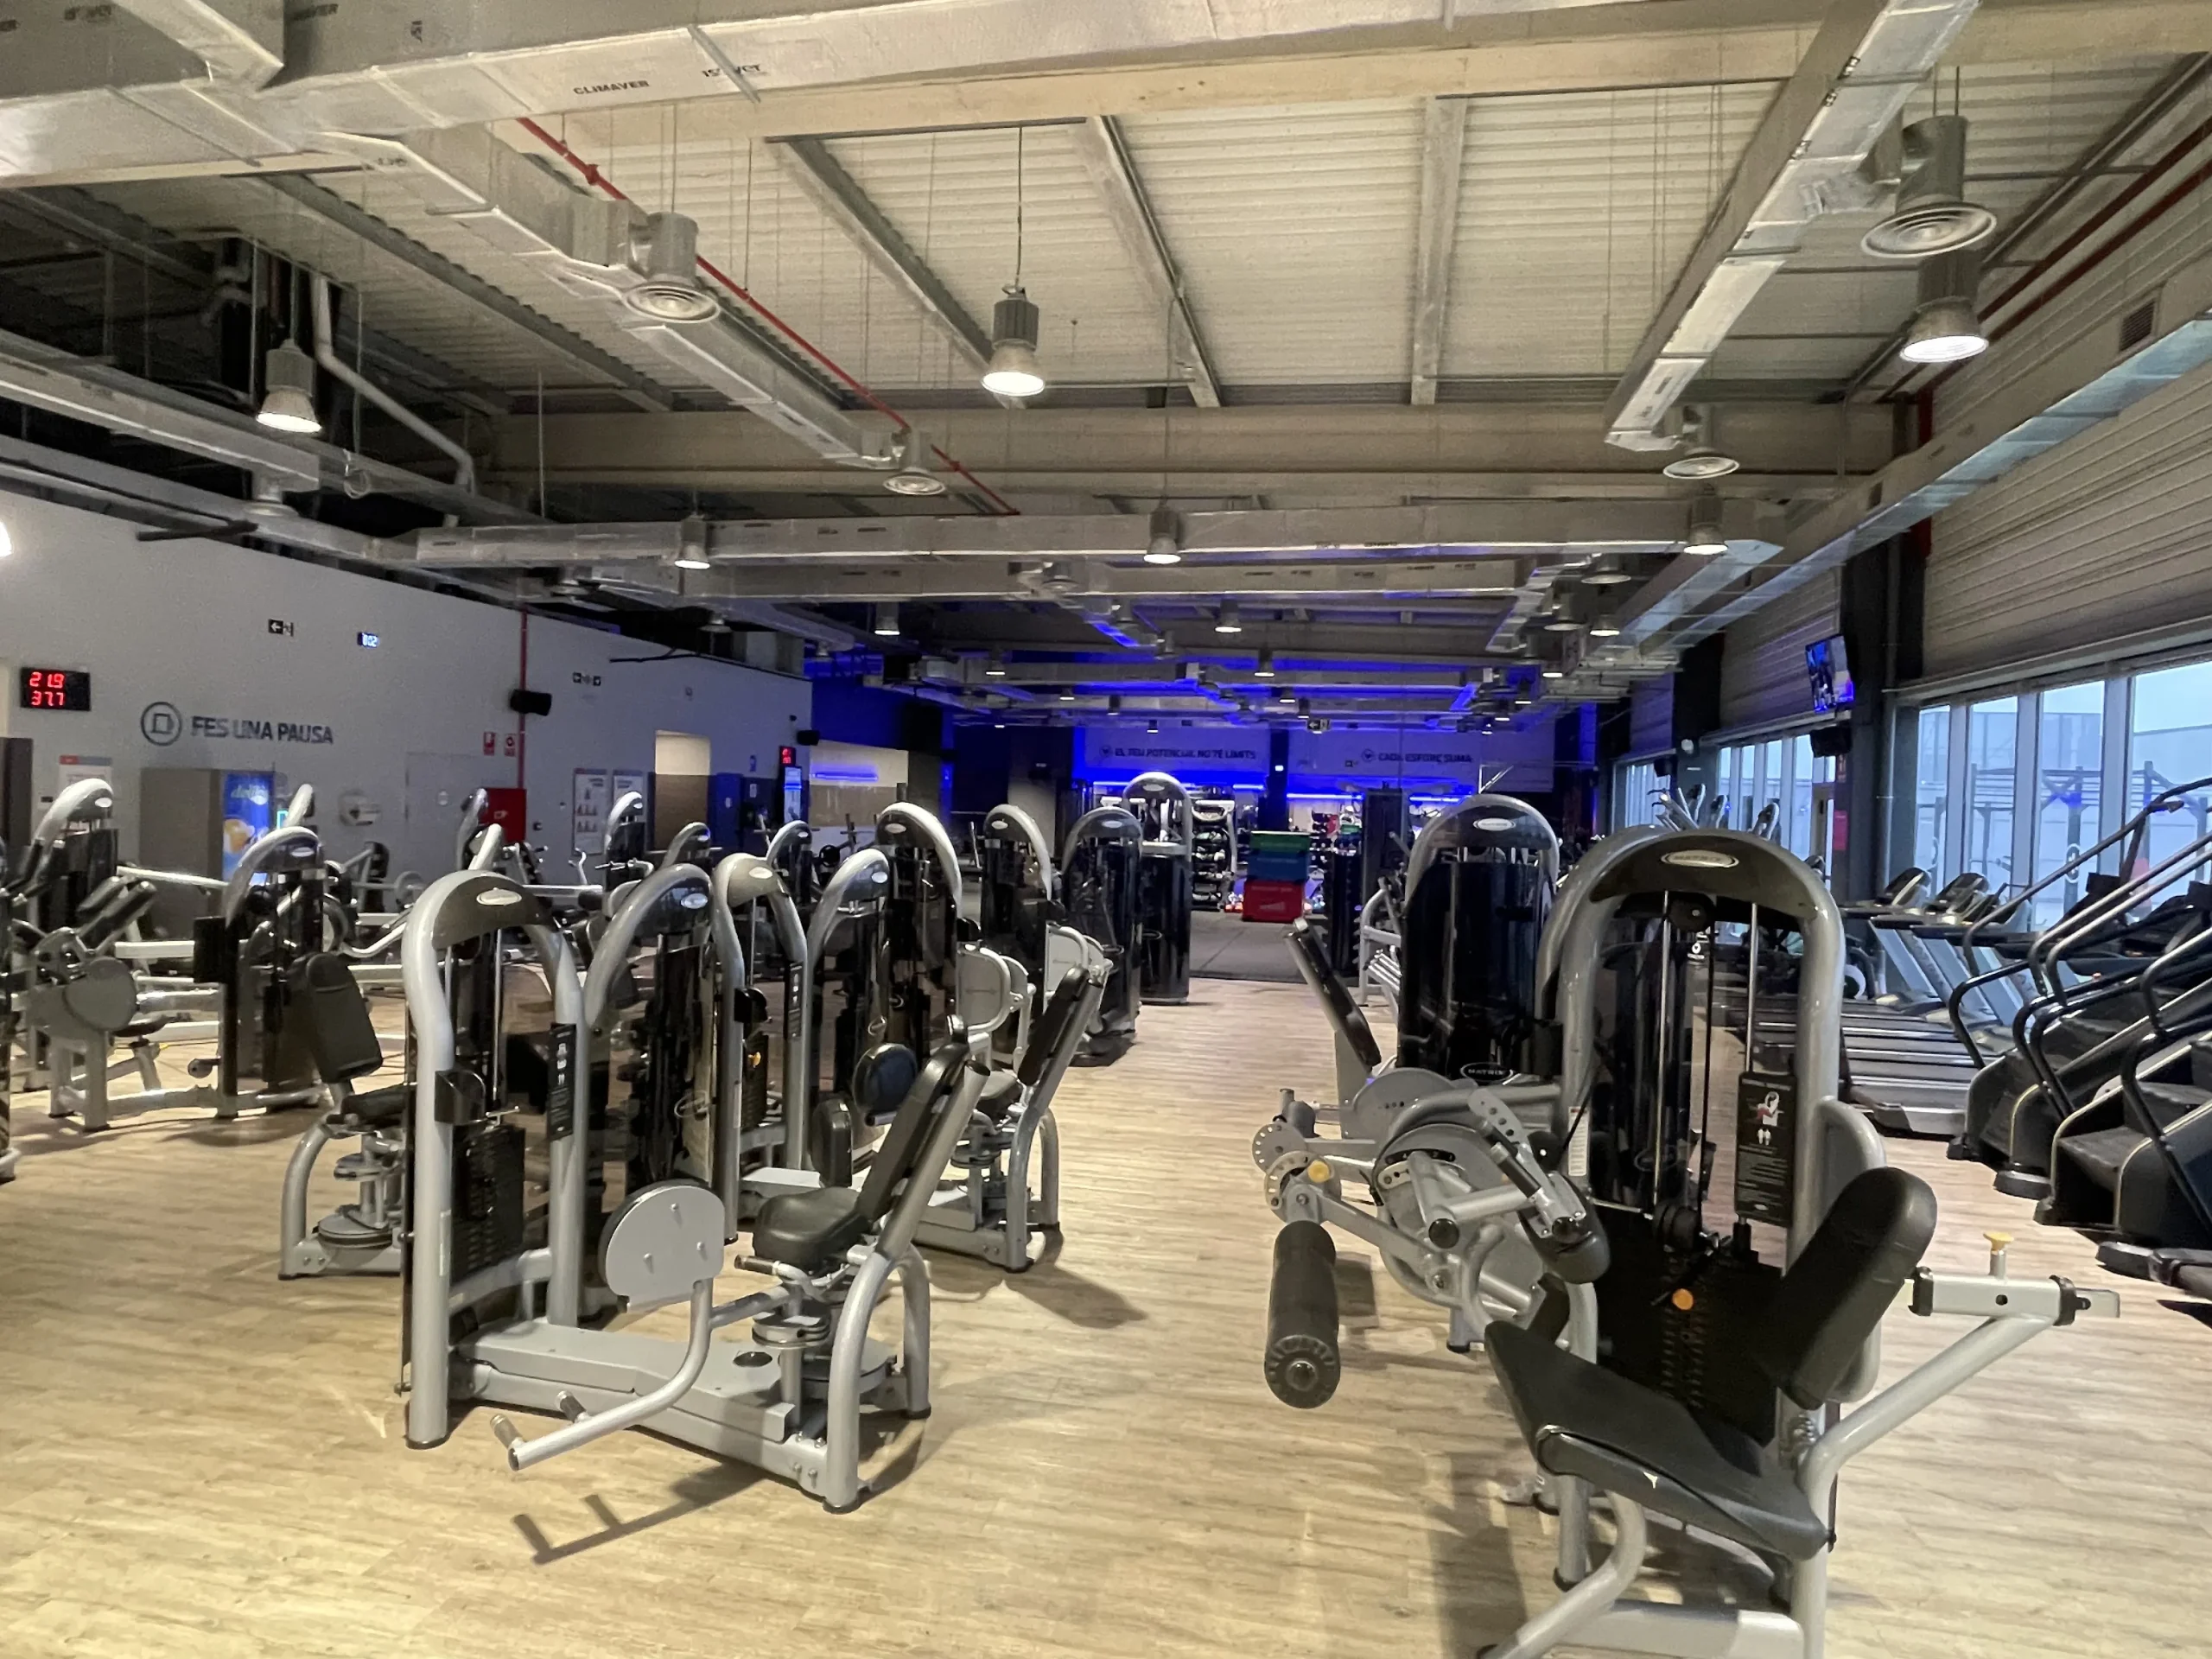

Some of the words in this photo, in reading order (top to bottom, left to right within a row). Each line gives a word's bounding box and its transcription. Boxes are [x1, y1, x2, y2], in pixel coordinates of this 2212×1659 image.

[573, 79, 650, 95] CLIMAVER
[192, 715, 229, 738] FES
[232, 719, 273, 741] UNA
[277, 722, 334, 745] PAUSA
